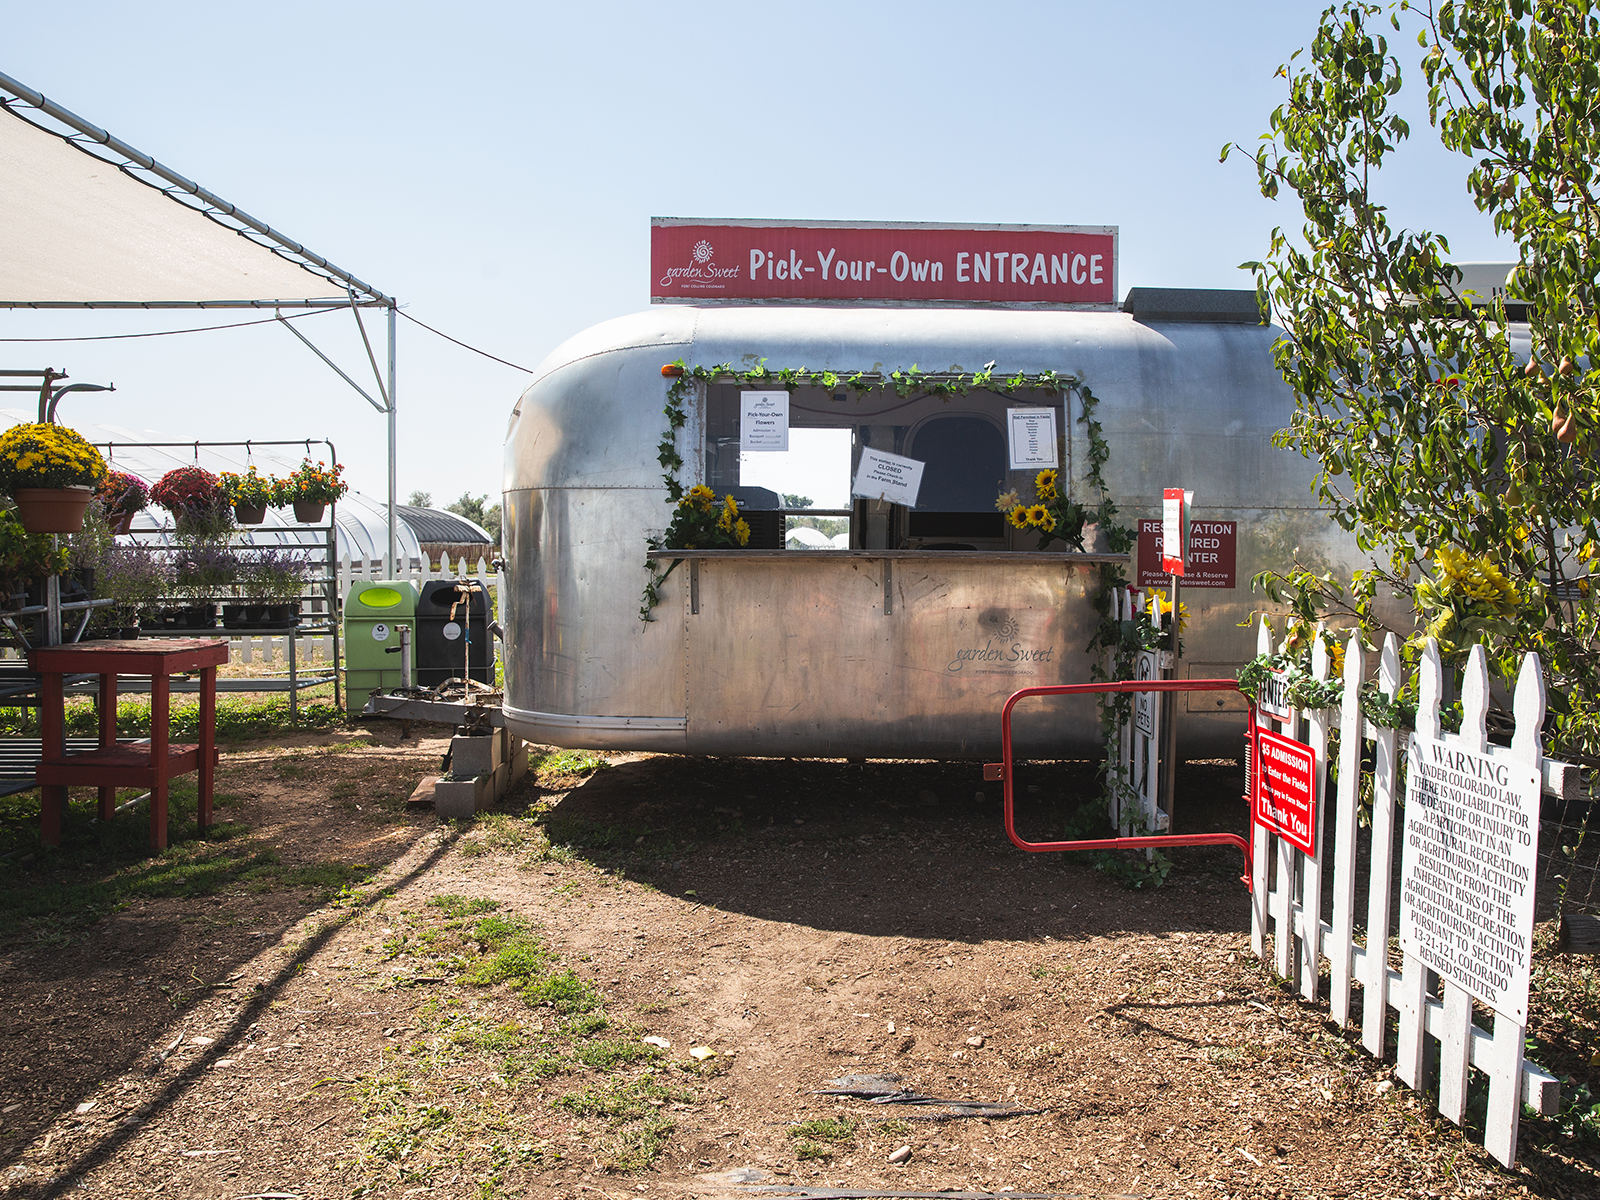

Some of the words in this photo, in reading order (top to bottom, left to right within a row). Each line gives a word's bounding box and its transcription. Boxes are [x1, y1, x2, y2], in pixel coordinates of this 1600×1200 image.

[660, 260, 702, 286] garden
[704, 262, 740, 278] Sweet
[750, 248, 943, 282] Pick-Your-Own
[956, 252, 1104, 285] ENTRANCE
[878, 464, 902, 474] CLOSED
[1155, 537, 1220, 549] RIRED
[948, 640, 1005, 672] garden
[1006, 643, 1054, 662] Sweet
[1138, 711, 1150, 728] PETS
[1140, 697, 1147, 711] NO
[1262, 742, 1270, 756] $5
[1271, 747, 1308, 774] ADMISSION
[1262, 763, 1267, 773] to
[1268, 765, 1282, 780] Enter
[1282, 773, 1291, 784] the
[1292, 776, 1308, 793] Fields
[1432, 744, 1508, 786] WARNING
[1262, 781, 1274, 793] Please
[1281, 791, 1285, 799] in
[1286, 794, 1295, 805] Farm
[1296, 799, 1308, 811] Stand
[1413, 775, 1439, 795] THERE
[1440, 786, 1447, 798] IS
[1449, 788, 1461, 803] NO
[1463, 793, 1507, 820] LIABILITY
[1509, 809, 1529, 829] FOR
[1420, 762, 1447, 783] UNDER
[1449, 772, 1497, 799] COLORADO
[1499, 789, 1521, 810] LAW,
[1261, 796, 1288, 826] Thank
[1290, 812, 1307, 837] You
[1410, 789, 1426, 805] THE
[1427, 795, 1454, 816] DEATH
[1456, 807, 1467, 821] OF
[1469, 812, 1481, 827] OR
[1483, 817, 1515, 840] INJURY
[1517, 829, 1531, 846] TO
[1423, 810, 1428, 822] A
[1430, 812, 1485, 844] PARTICIPANT
[1486, 836, 1496, 850] IN
[1498, 840, 1511, 856] AN
[1408, 819, 1468, 855] AGRICULTURAL
[1470, 844, 1529, 881] RECREATION
[1410, 834, 1420, 849] OR
[1421, 840, 1479, 876] AGRITOURISM
[1481, 867, 1526, 897] ACTIVITY
[1414, 866, 1454, 896] INHERENT
[1456, 887, 1480, 909] RISKS
[1482, 900, 1495, 916] OF
[1496, 906, 1516, 928] THE
[1419, 853, 1462, 884] RESULTING
[1464, 874, 1490, 897] FROM
[1492, 887, 1511, 908] THE
[1404, 891, 1415, 907] OR
[1416, 898, 1475, 940] AGRITOURISM
[1477, 932, 1524, 969] ACTIVITY,
[1405, 878, 1464, 918] AGRICULTURAL
[1466, 908, 1525, 949] RECREATION
[1411, 910, 1454, 944] PURSUANT
[1456, 935, 1468, 952] TO
[1472, 944, 1514, 978] SECTION
[1414, 927, 1456, 964] 13-21-121,
[1458, 953, 1508, 991] COLORADO
[1420, 945, 1452, 974] REVISED
[1453, 966, 1497, 1003] STATUTES.
